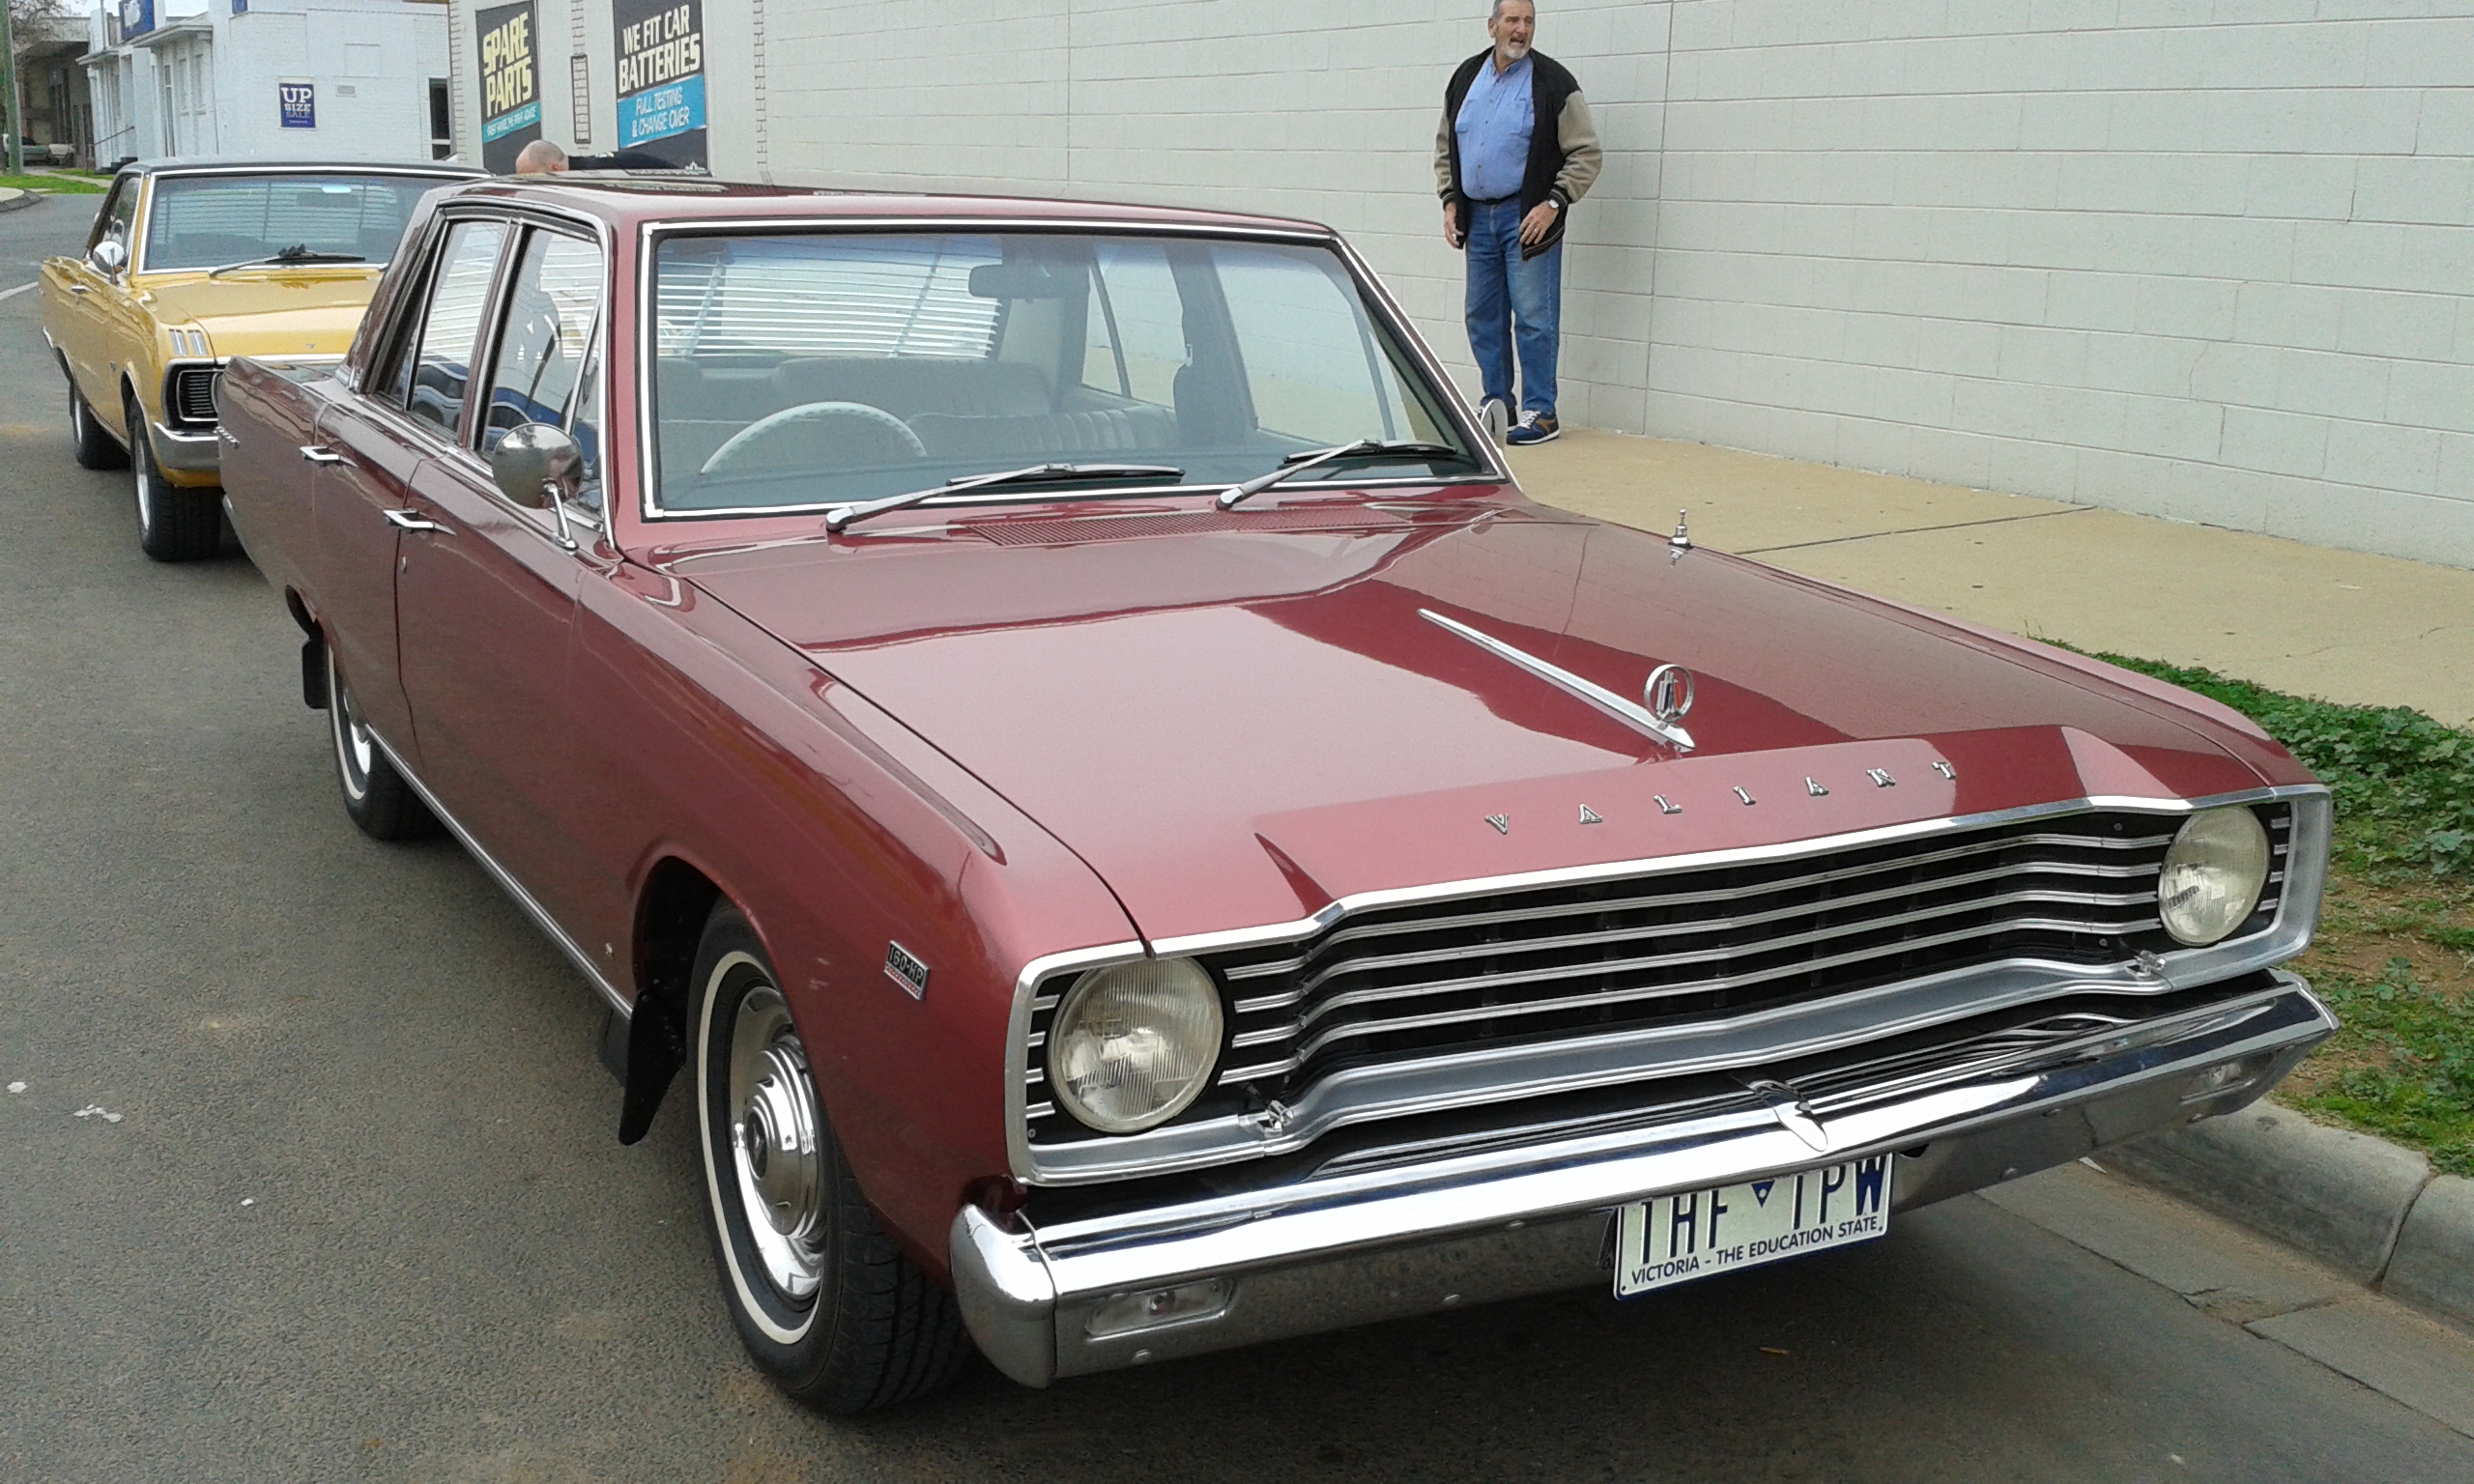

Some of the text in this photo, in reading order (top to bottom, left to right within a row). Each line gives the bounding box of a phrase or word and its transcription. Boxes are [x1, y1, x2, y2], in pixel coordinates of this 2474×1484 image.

[483, 12, 530, 76] SPARE
[622, 4, 690, 55] WE FIT CAR
[486, 56, 532, 118] PARTS
[618, 33, 701, 94] BATTERIES
[280, 87, 312, 103] UP
[284, 102, 311, 112] SIZE
[638, 111, 668, 135] CHANGE
[668, 105, 690, 129] OVER
[1631, 1257, 1700, 1285] VICTORIA
[1716, 1245, 1744, 1265] THE
[1748, 1226, 1833, 1258] EDUCATION
[1838, 1215, 1878, 1239] STATE
